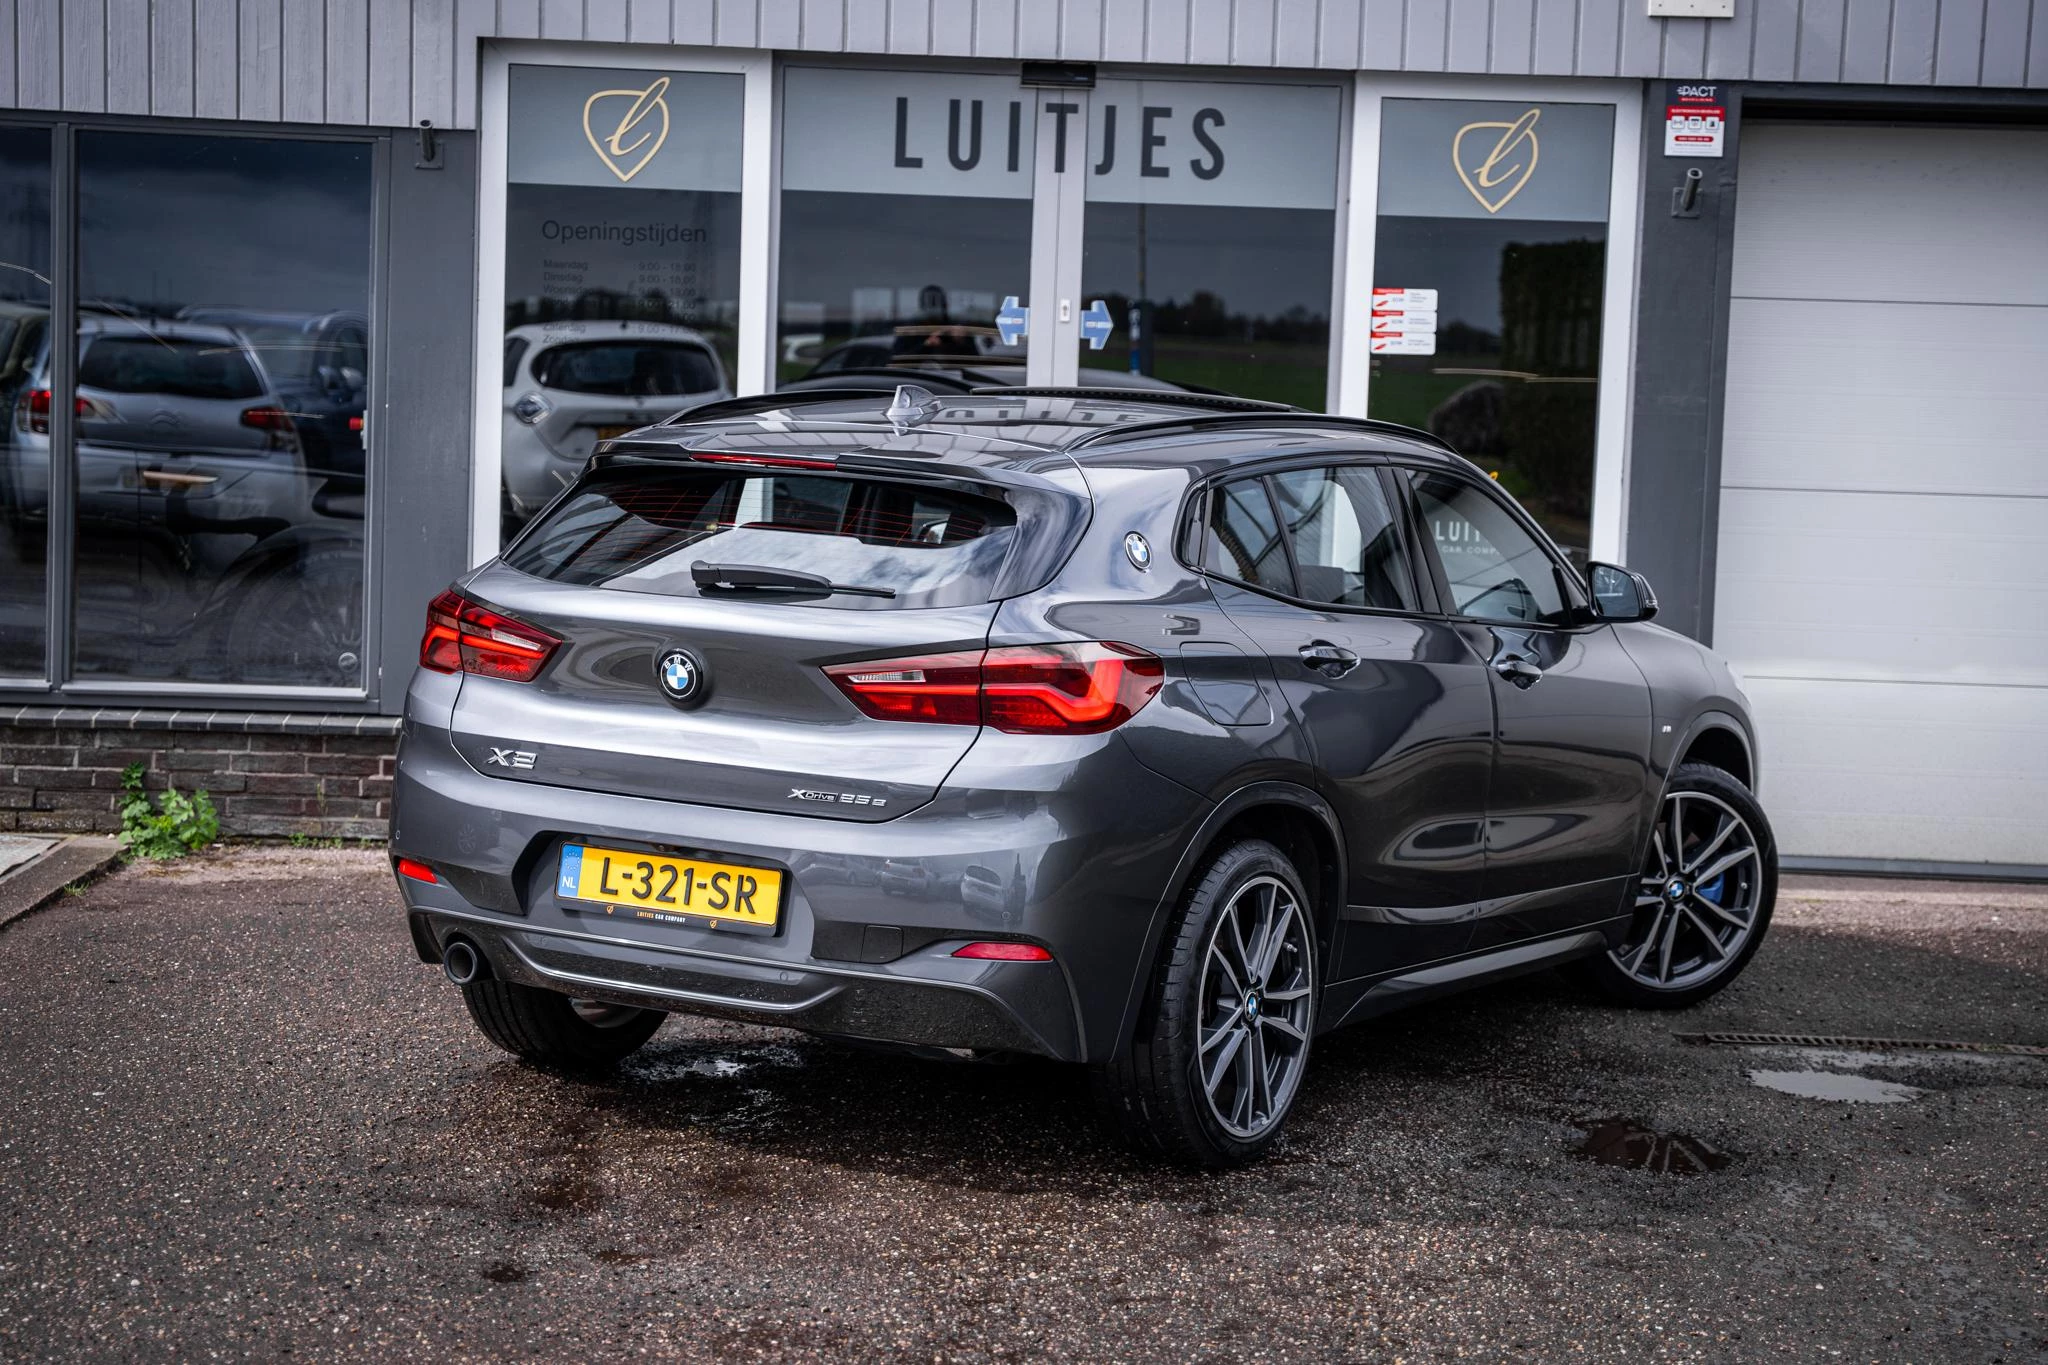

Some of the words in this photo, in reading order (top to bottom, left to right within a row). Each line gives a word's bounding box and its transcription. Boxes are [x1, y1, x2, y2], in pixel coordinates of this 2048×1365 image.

[894, 96, 1226, 181] LUITJES
[541, 220, 707, 246] Openingstijden
[1467, 546, 1500, 556] COMP
[487, 747, 538, 770] X2
[561, 876, 577, 889] NL
[599, 857, 758, 915] L-321-SR
